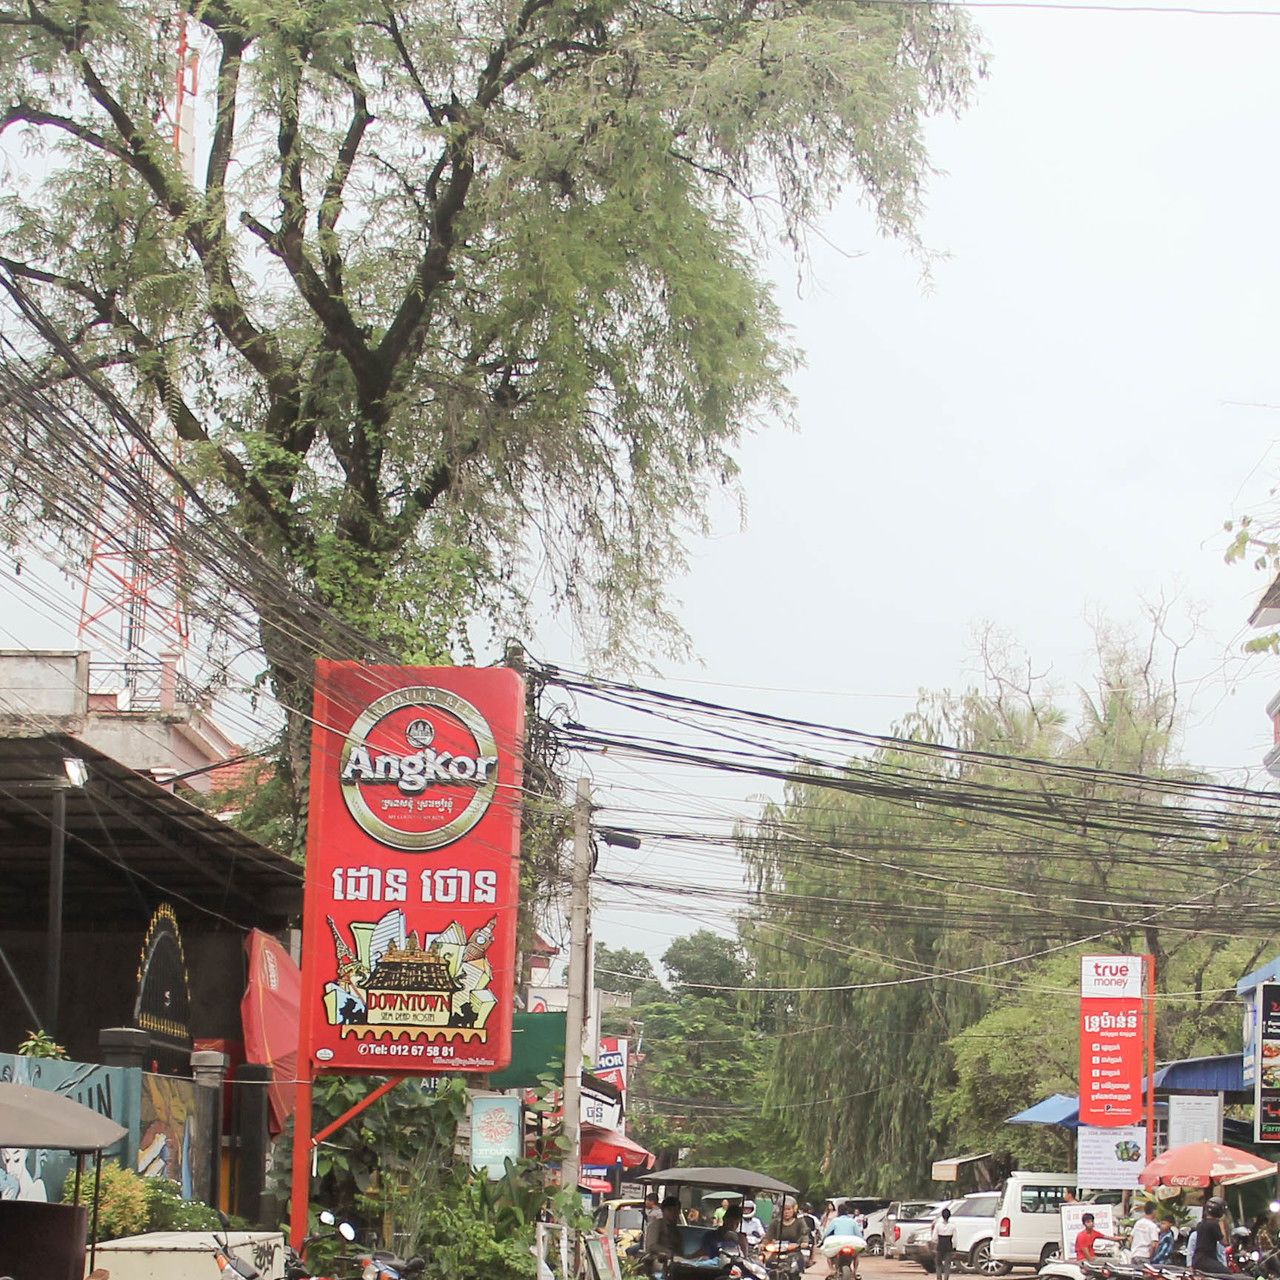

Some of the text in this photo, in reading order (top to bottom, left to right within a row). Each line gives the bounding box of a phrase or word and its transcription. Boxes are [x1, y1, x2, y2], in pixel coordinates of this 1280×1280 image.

[341, 744, 498, 791] Angkor
[1094, 962, 1129, 977] true
[1093, 977, 1128, 989] money
[368, 991, 451, 1012] DOWNTOWN
[369, 1044, 454, 1057] Tel: 012 67 58 81
